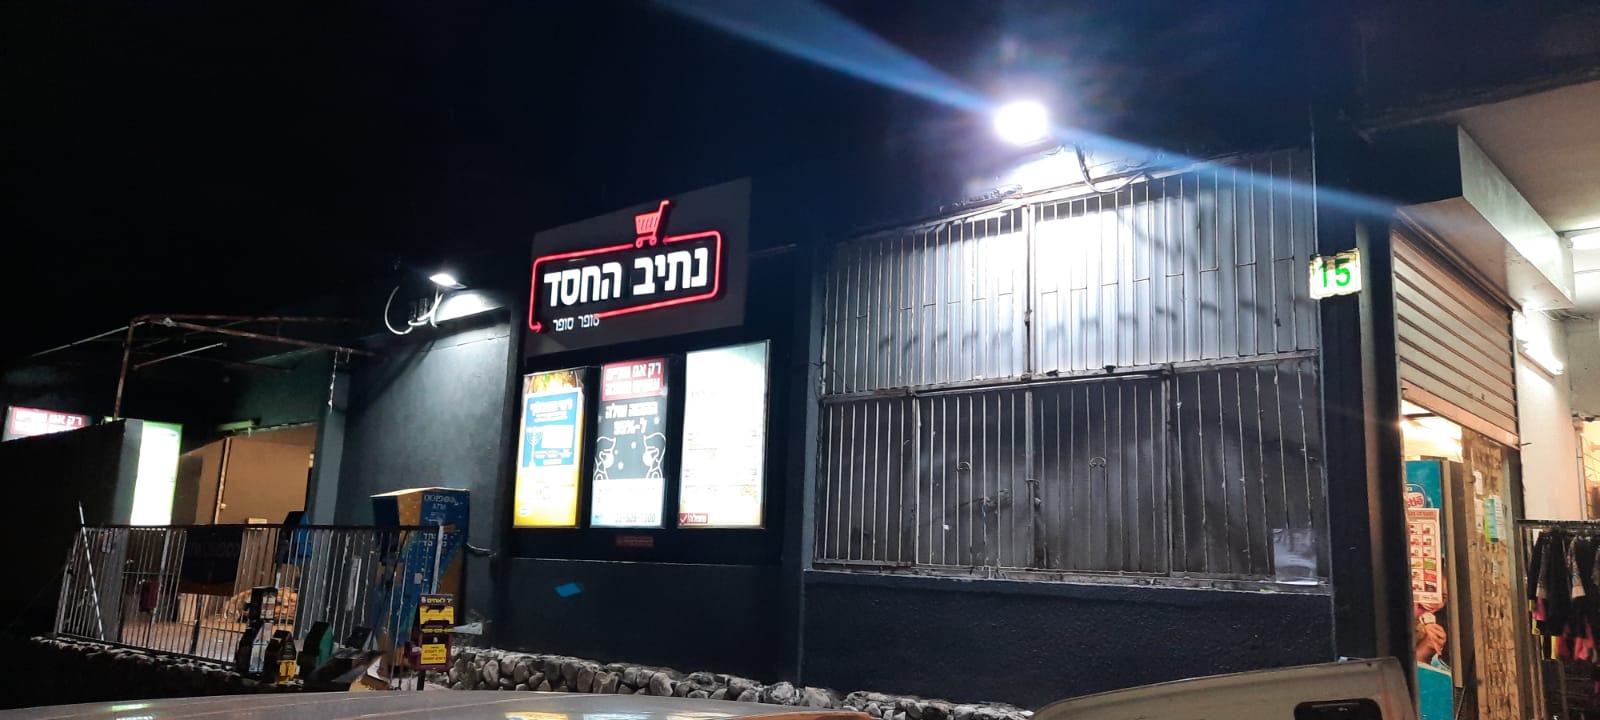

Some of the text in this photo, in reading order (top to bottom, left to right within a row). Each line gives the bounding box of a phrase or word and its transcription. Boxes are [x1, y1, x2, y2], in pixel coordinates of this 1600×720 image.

[543, 247, 708, 307] נתיב החסד
[1318, 257, 1351, 288] 15
[553, 313, 600, 331] סופר סופר
[631, 364, 647, 378] אם
[647, 362, 661, 379] רק
[66, 415, 82, 428] רק
